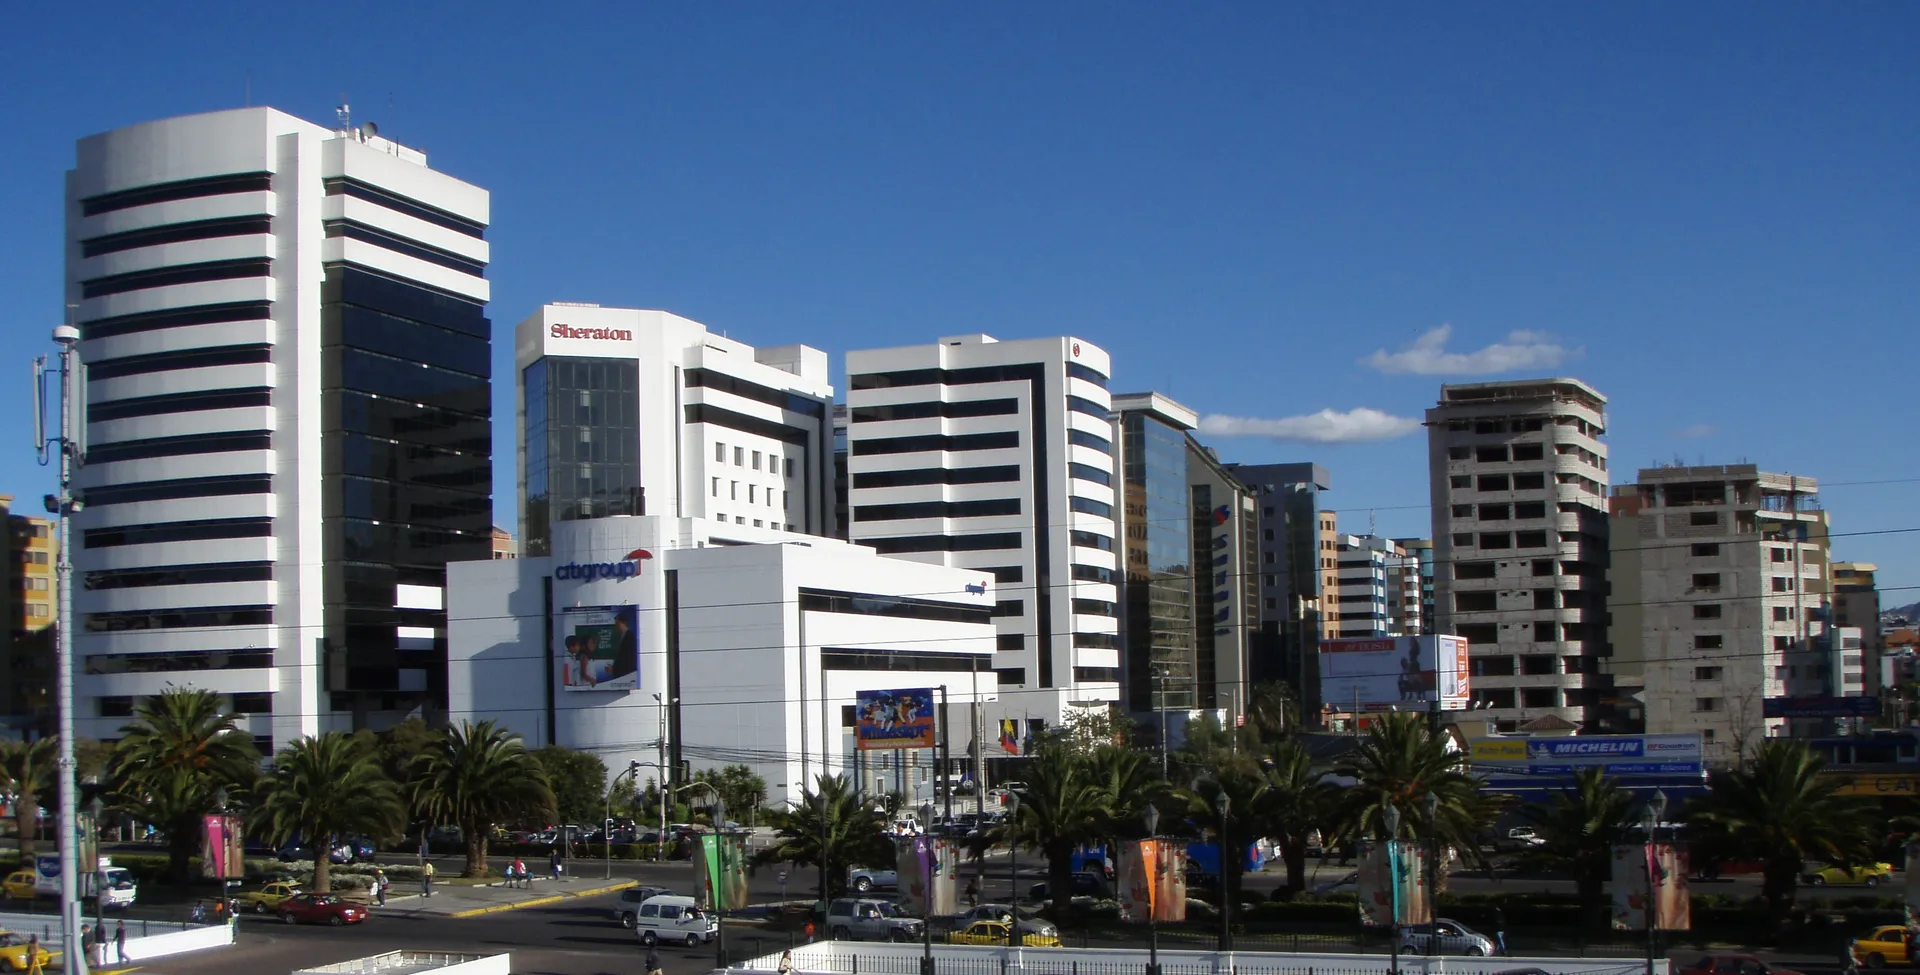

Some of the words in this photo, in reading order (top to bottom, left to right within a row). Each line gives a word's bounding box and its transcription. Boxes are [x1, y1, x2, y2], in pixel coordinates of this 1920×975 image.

[551, 323, 632, 341] Sheraton
[555, 561, 635, 583] citigroup
[1554, 742, 1638, 753] MICHELIN
